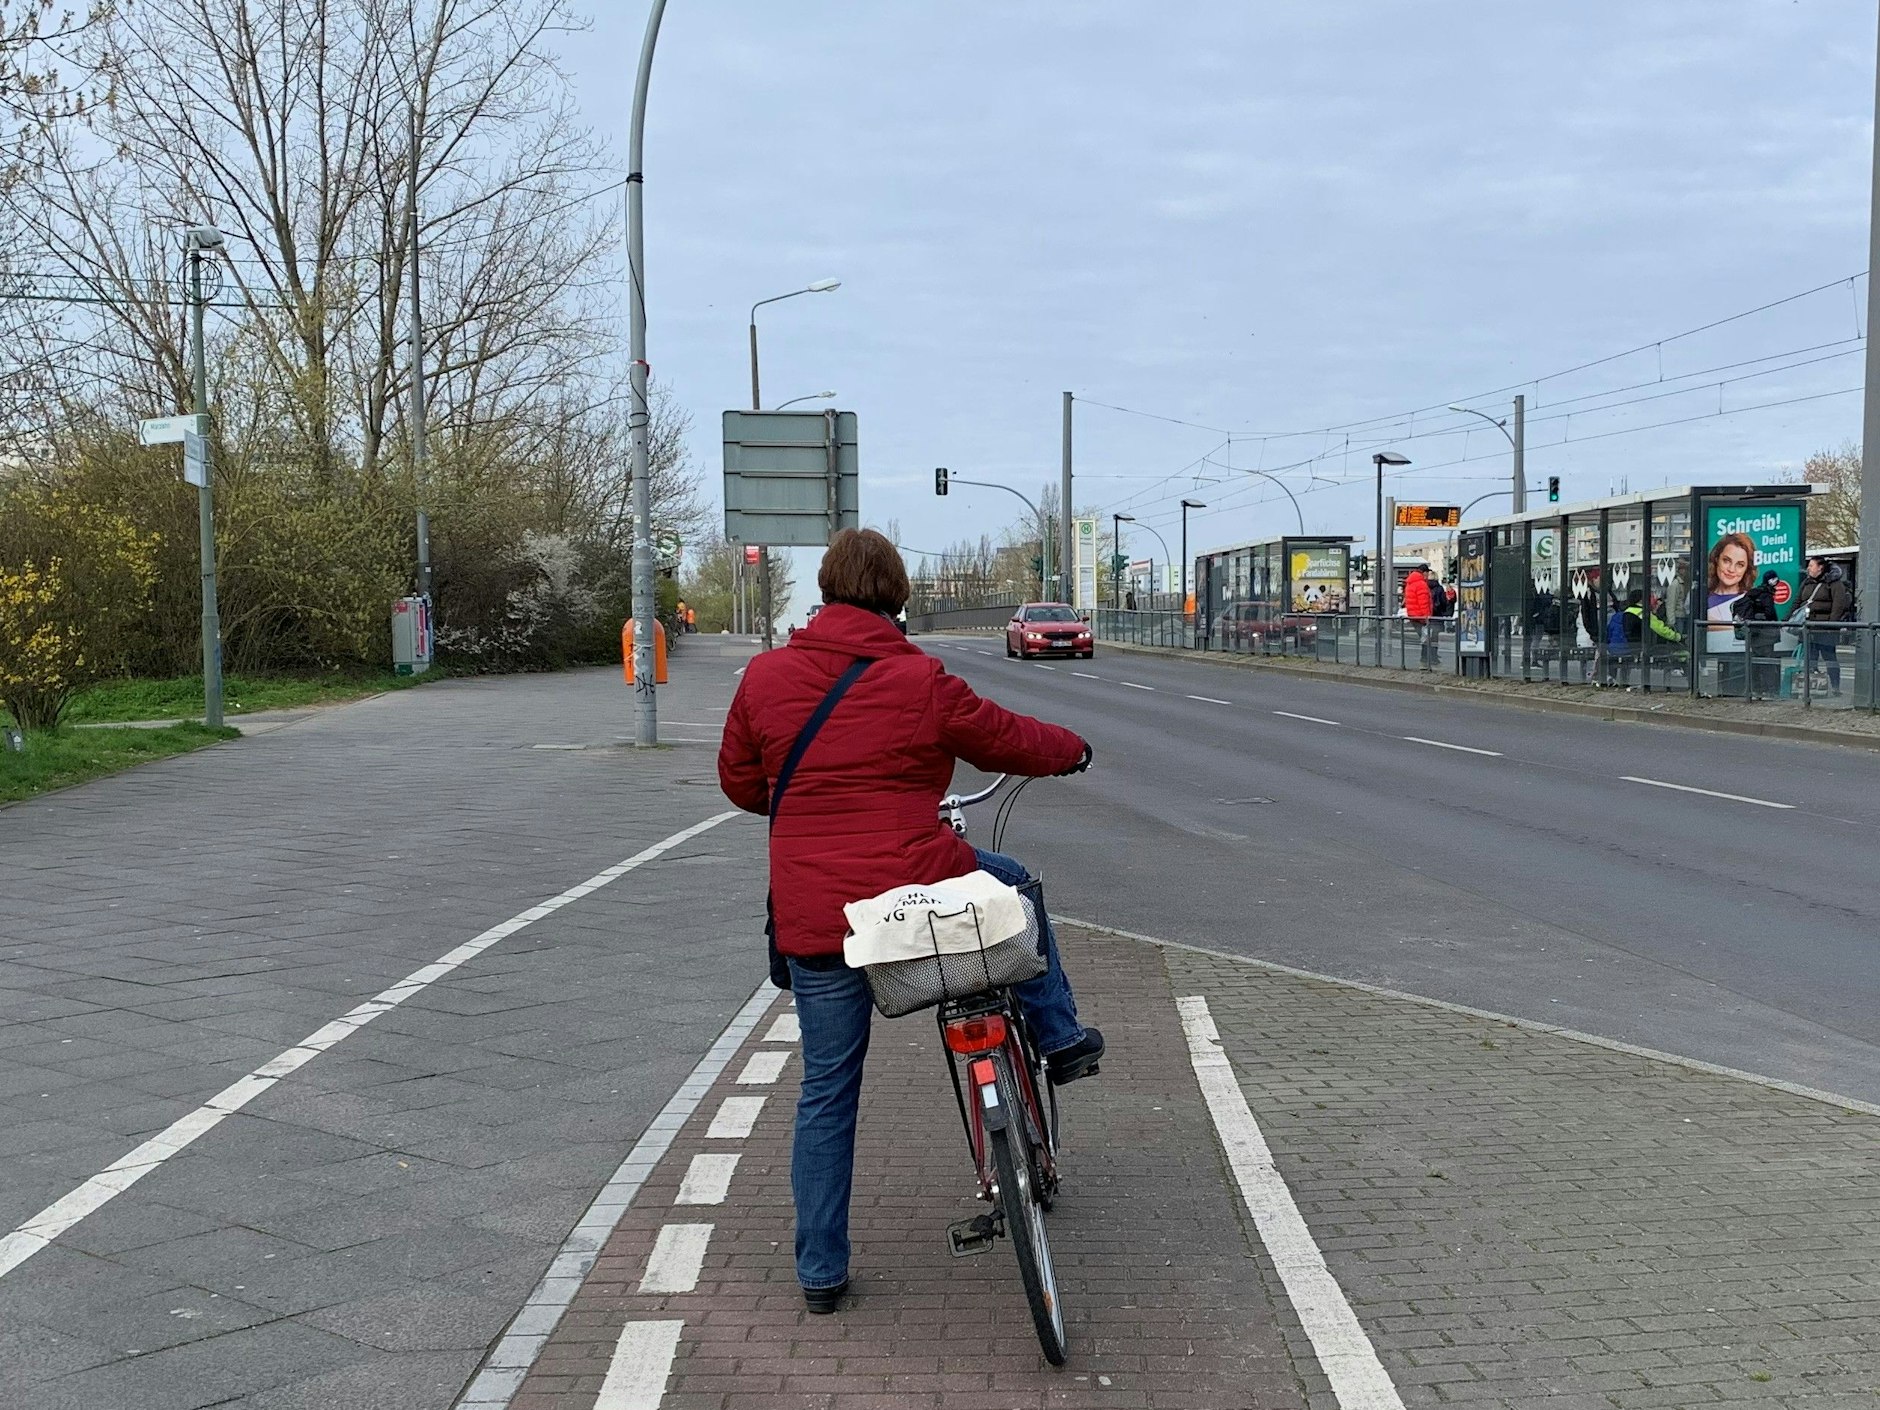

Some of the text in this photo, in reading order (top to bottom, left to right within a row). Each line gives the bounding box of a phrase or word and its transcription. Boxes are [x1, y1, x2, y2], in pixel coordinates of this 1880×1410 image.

[1716, 512, 1781, 536] Schreib!
[1761, 533, 1787, 546] Dein!
[1753, 546, 1794, 566] Buch!
